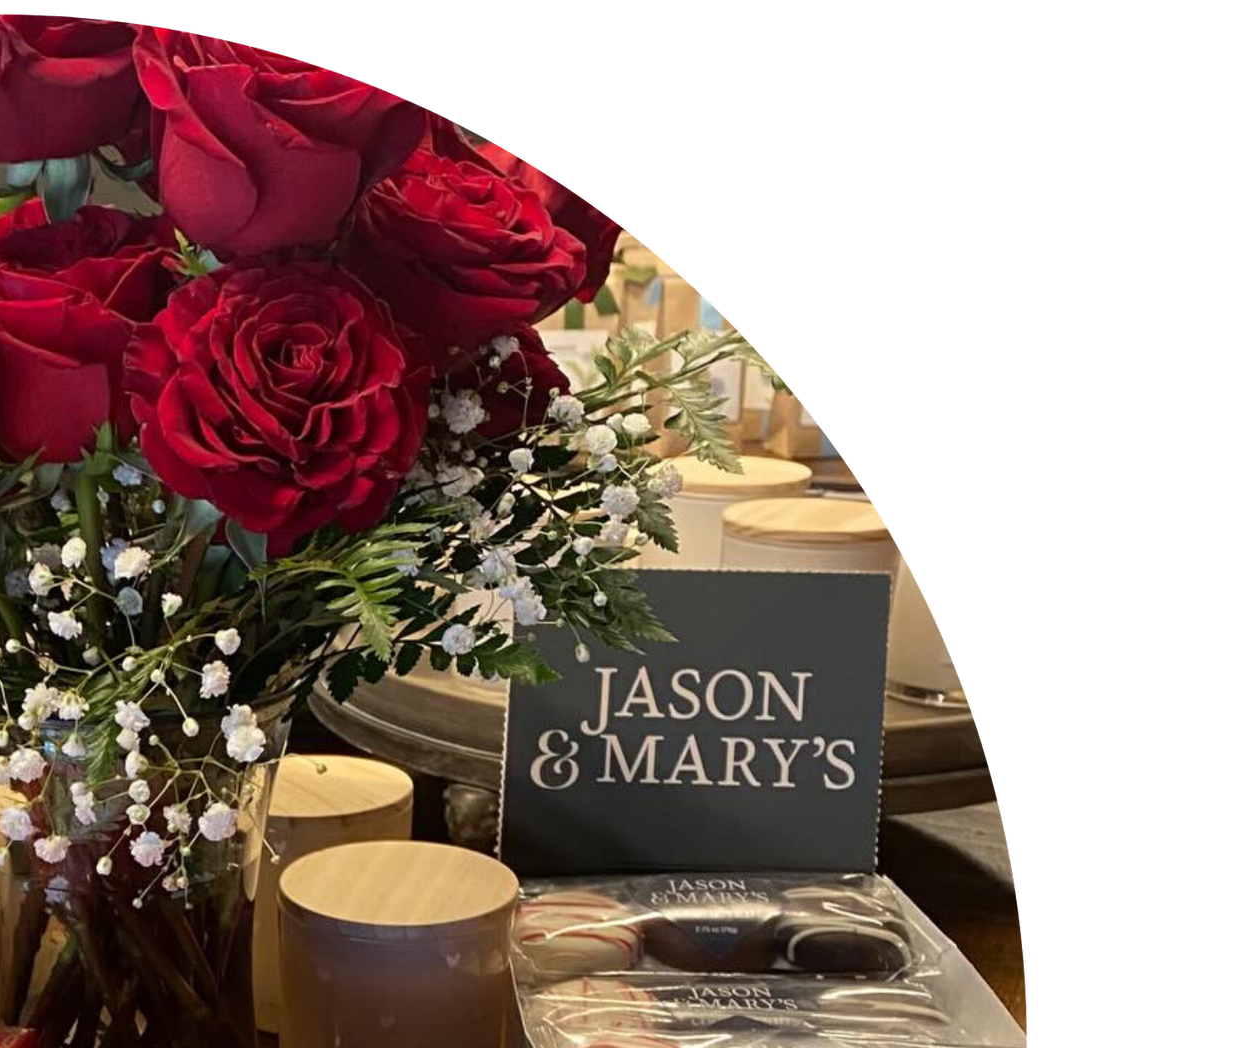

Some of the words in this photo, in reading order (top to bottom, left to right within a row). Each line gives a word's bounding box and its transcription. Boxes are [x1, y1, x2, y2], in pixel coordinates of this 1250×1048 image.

[580, 665, 813, 737] JASON
[530, 729, 579, 790] &
[596, 734, 856, 790] MARY'S
[666, 879, 746, 895] JASON
[676, 891, 770, 903] MARY'S
[688, 986, 771, 999] JASON
[699, 998, 798, 1010] MARY'S
